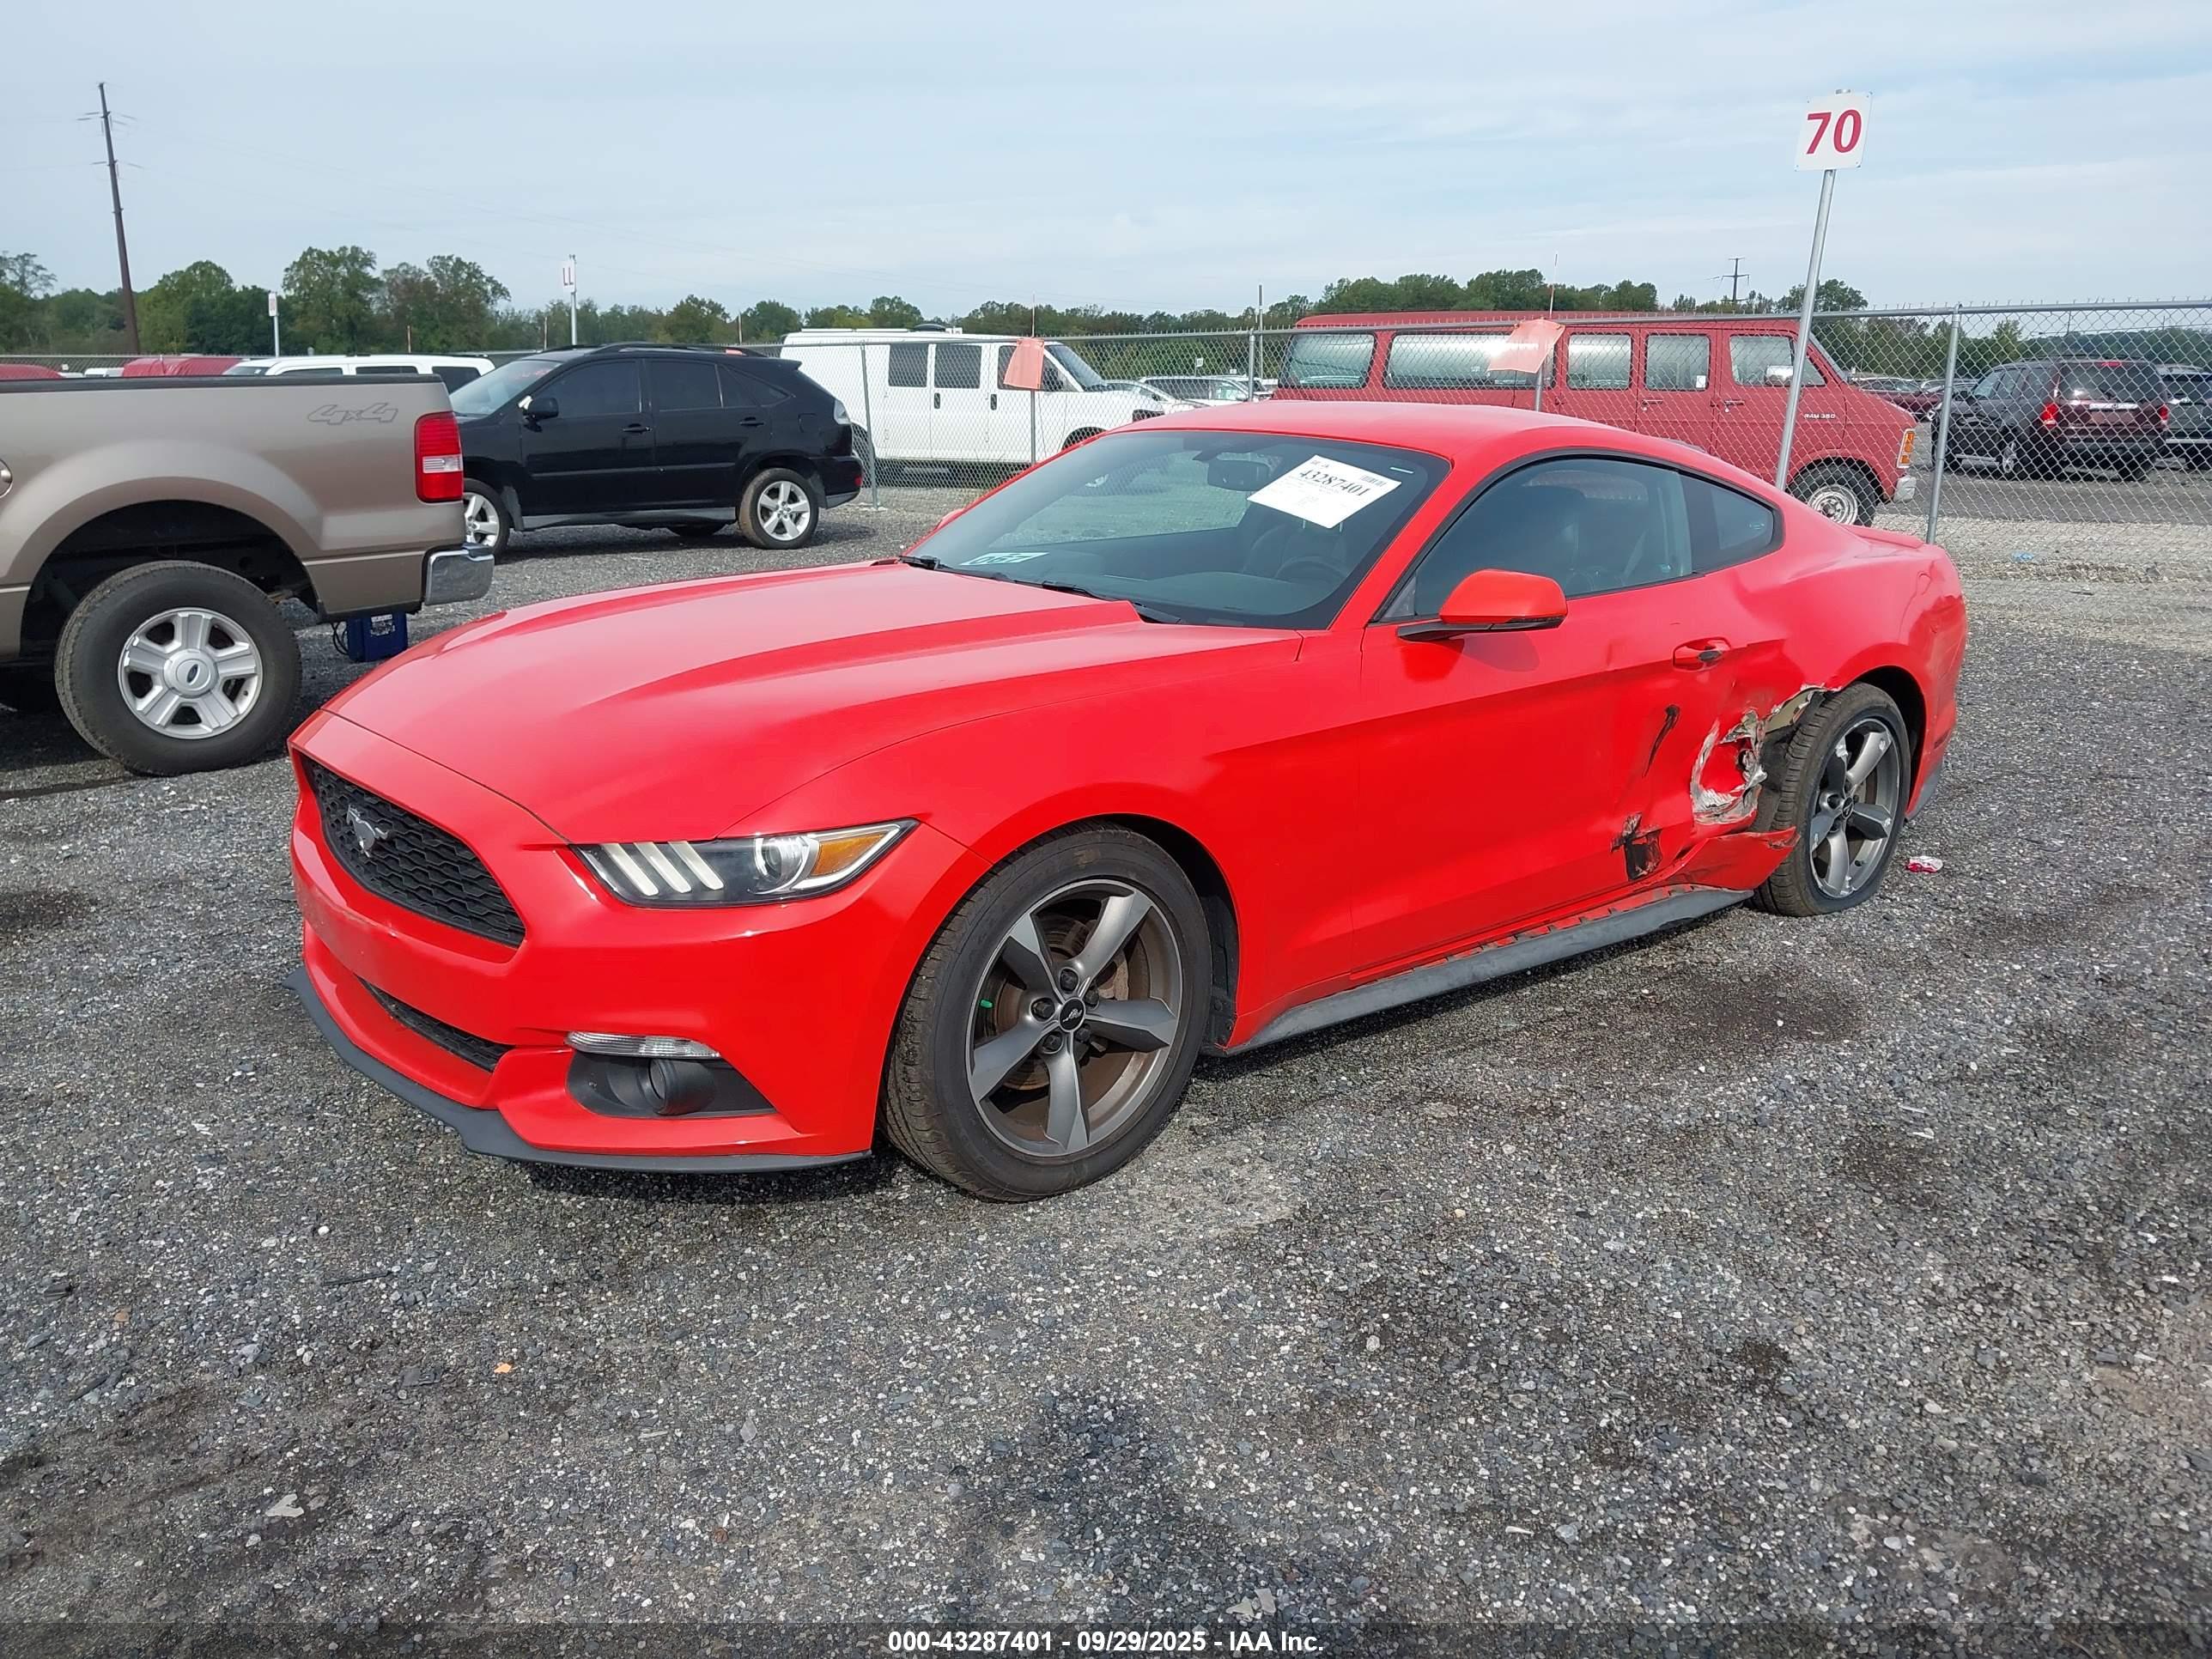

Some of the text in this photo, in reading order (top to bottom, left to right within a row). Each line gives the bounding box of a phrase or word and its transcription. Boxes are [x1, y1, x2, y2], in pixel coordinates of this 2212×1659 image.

[1806, 109, 1862, 155] 70
[307, 402, 398, 426] 4x4
[1299, 469, 1371, 496] 43287401
